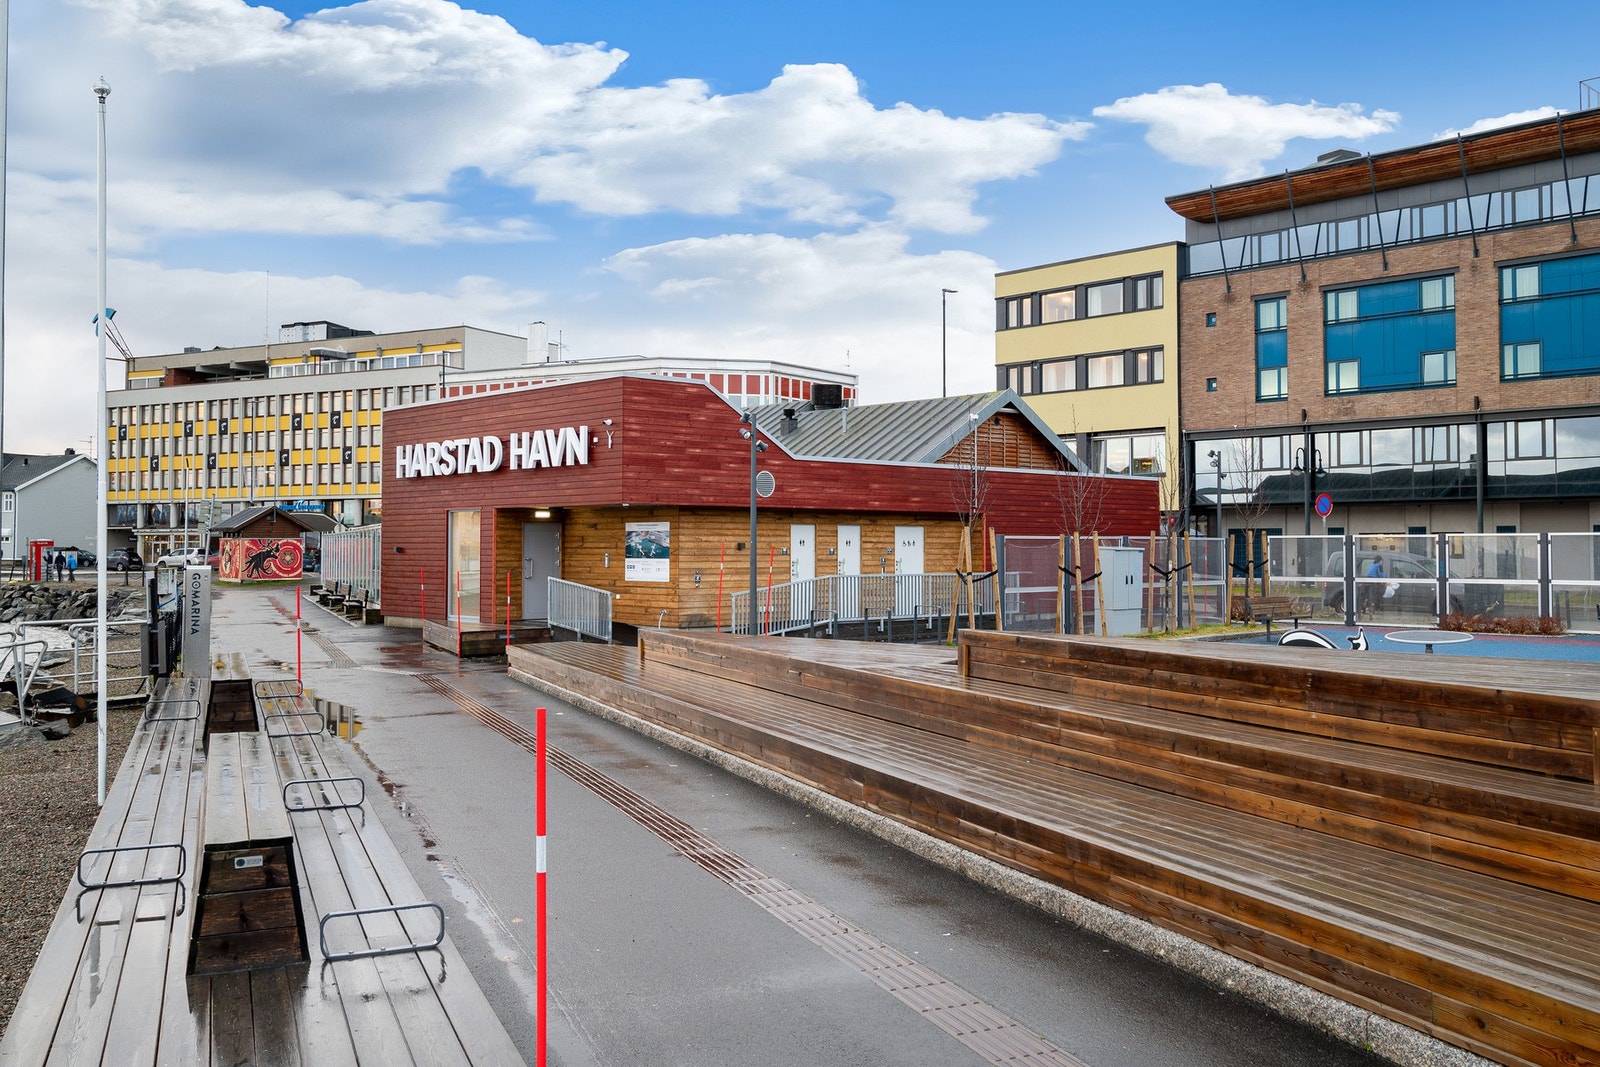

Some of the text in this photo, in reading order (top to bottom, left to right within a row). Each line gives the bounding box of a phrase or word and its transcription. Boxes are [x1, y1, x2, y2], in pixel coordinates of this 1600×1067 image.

[396, 425, 589, 479] HARSTAD HAVN
[190, 572, 201, 635] GOMARINA
